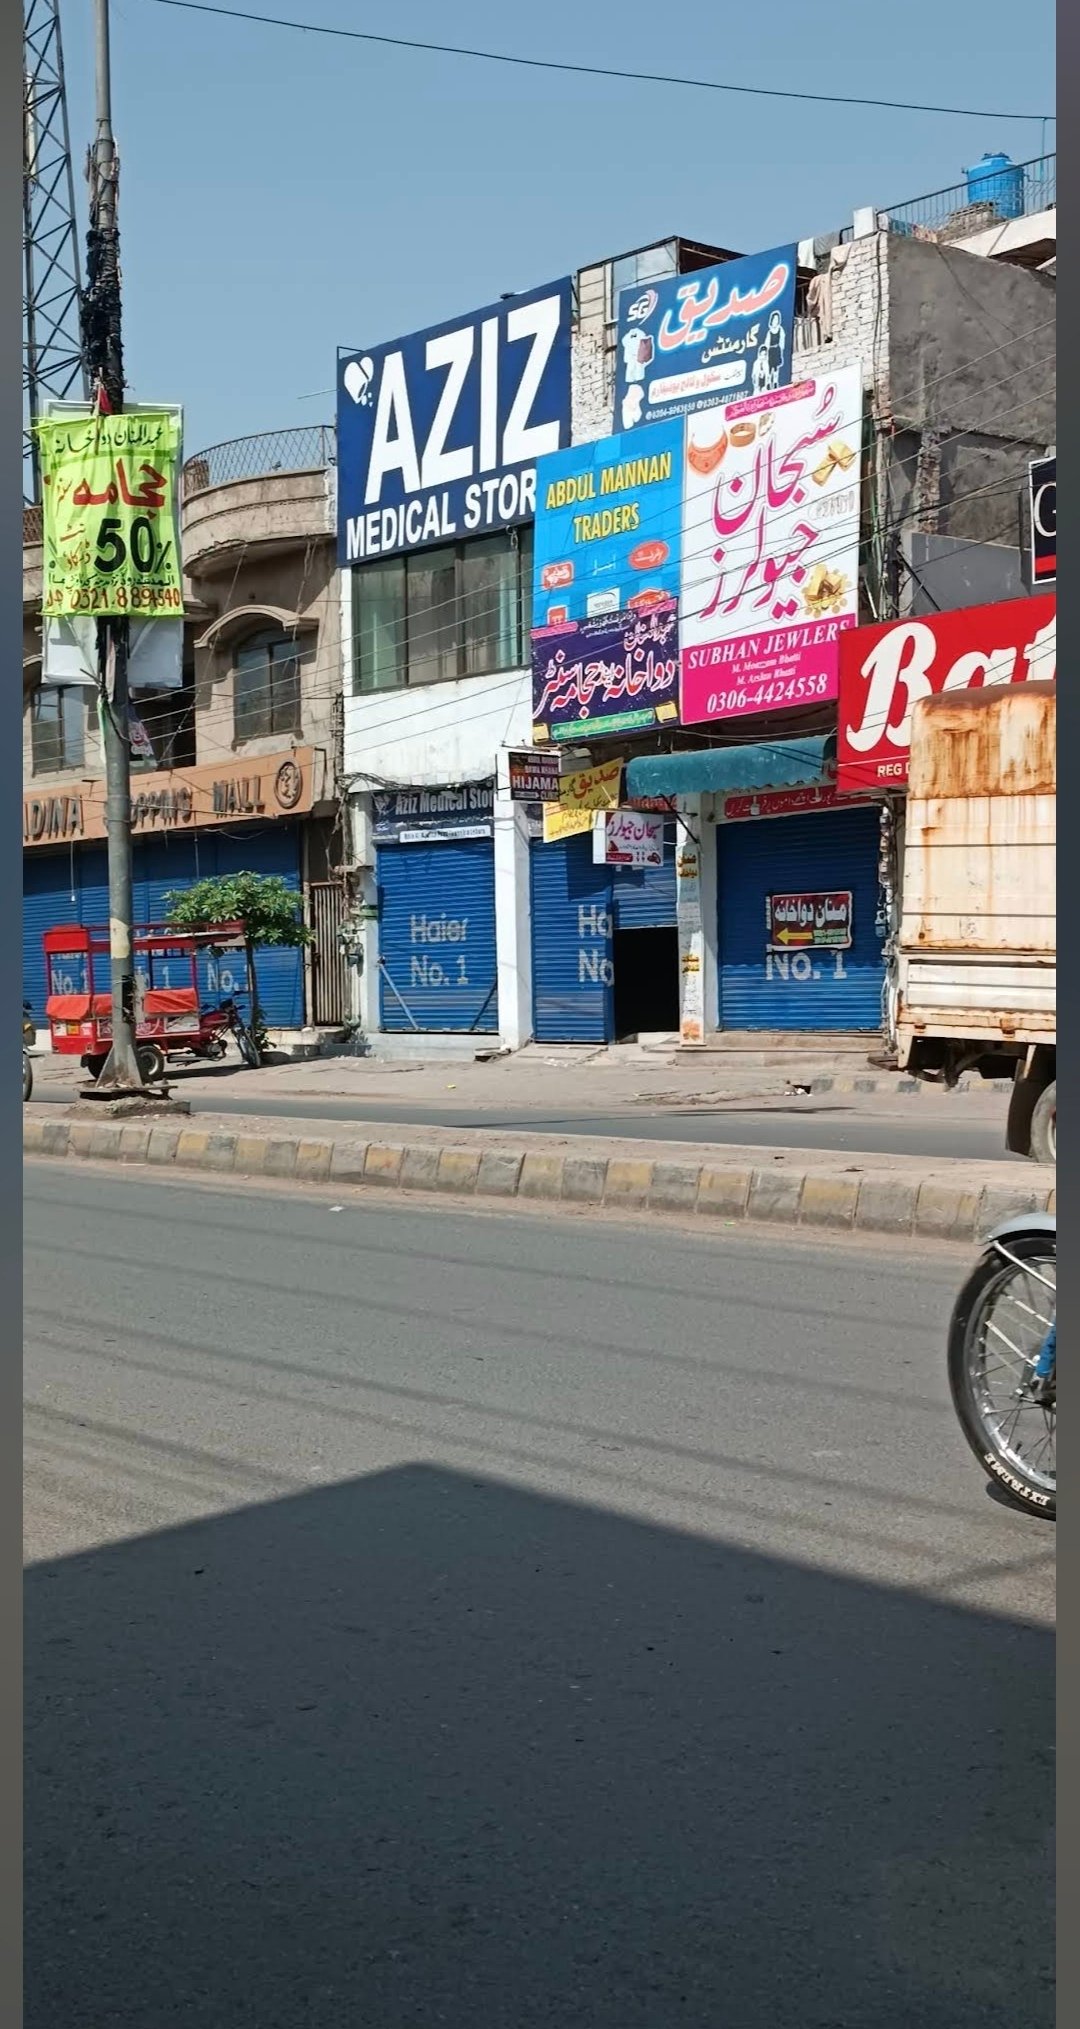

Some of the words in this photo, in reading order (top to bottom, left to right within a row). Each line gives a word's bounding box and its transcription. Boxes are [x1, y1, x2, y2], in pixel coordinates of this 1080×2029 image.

[658, 264, 789, 350] صدیق
[364, 295, 561, 505] AZIZ
[546, 473, 596, 511] ABDUL
[600, 451, 672, 495] MANNAN
[346, 495, 456, 560] MEDICAL
[573, 502, 640, 544] TRADERS
[688, 637, 760, 669] SUBHAN
[707, 673, 828, 714] 0306-4424558
[512, 775, 559, 790] HIJAMA
[877, 762, 903, 778] REG
[24, 793, 85, 841] DINA
[411, 912, 469, 943] Haier
[410, 955, 451, 986] No.
[456, 954, 470, 985] 1
[984, 1453, 1051, 1506] EXTREME
